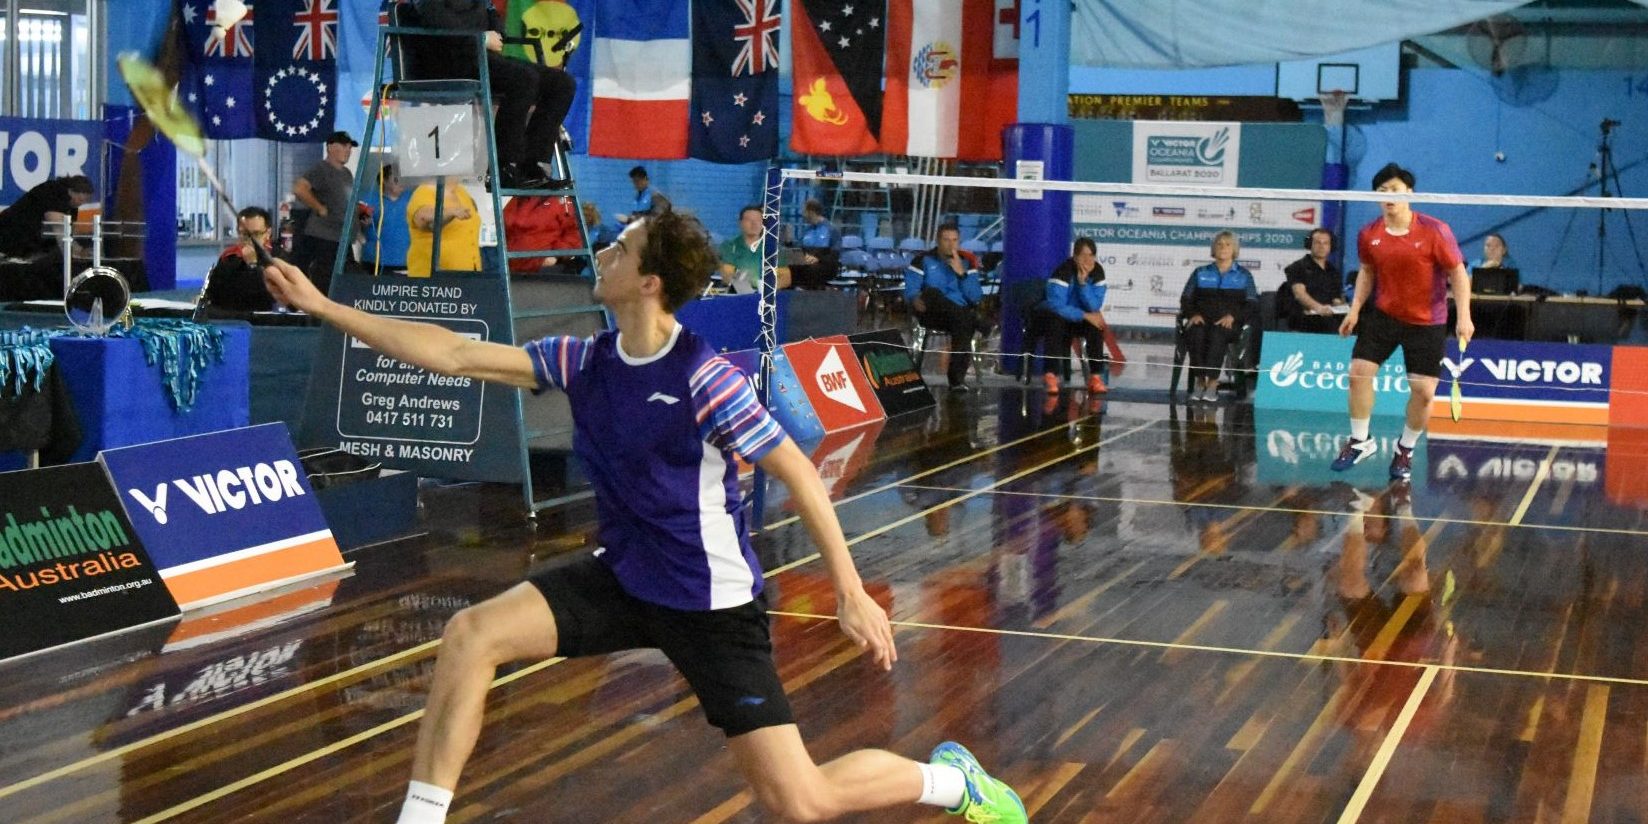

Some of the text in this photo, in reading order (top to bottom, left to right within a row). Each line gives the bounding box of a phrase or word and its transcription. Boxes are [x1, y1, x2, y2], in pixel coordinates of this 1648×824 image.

[1110, 96, 1162, 106] PREMIER
[1171, 97, 1209, 107] TEAMS
[428, 125, 440, 159] 1
[1149, 147, 1195, 156] OCEANIA
[1150, 168, 1192, 177] BALLARAT
[1073, 226, 1115, 238] VICTOR
[1117, 228, 1167, 239] OCEANIA
[1264, 234, 1293, 244] 2020
[372, 284, 462, 299] UMPIRE STAND
[353, 299, 478, 315] KINDLY DONATED BY
[376, 354, 396, 368] for
[355, 368, 472, 388] Computer Needs
[1480, 357, 1603, 385] VICTOR
[820, 370, 848, 393] BWF
[361, 392, 460, 411] Greg Andrews
[366, 410, 454, 428] 0417 511 731
[338, 441, 474, 463] MESH & MASONRY
[173, 459, 305, 515] VICTOR
[0, 551, 142, 592] Australia
[58, 577, 153, 604] www.badminton.org.au
